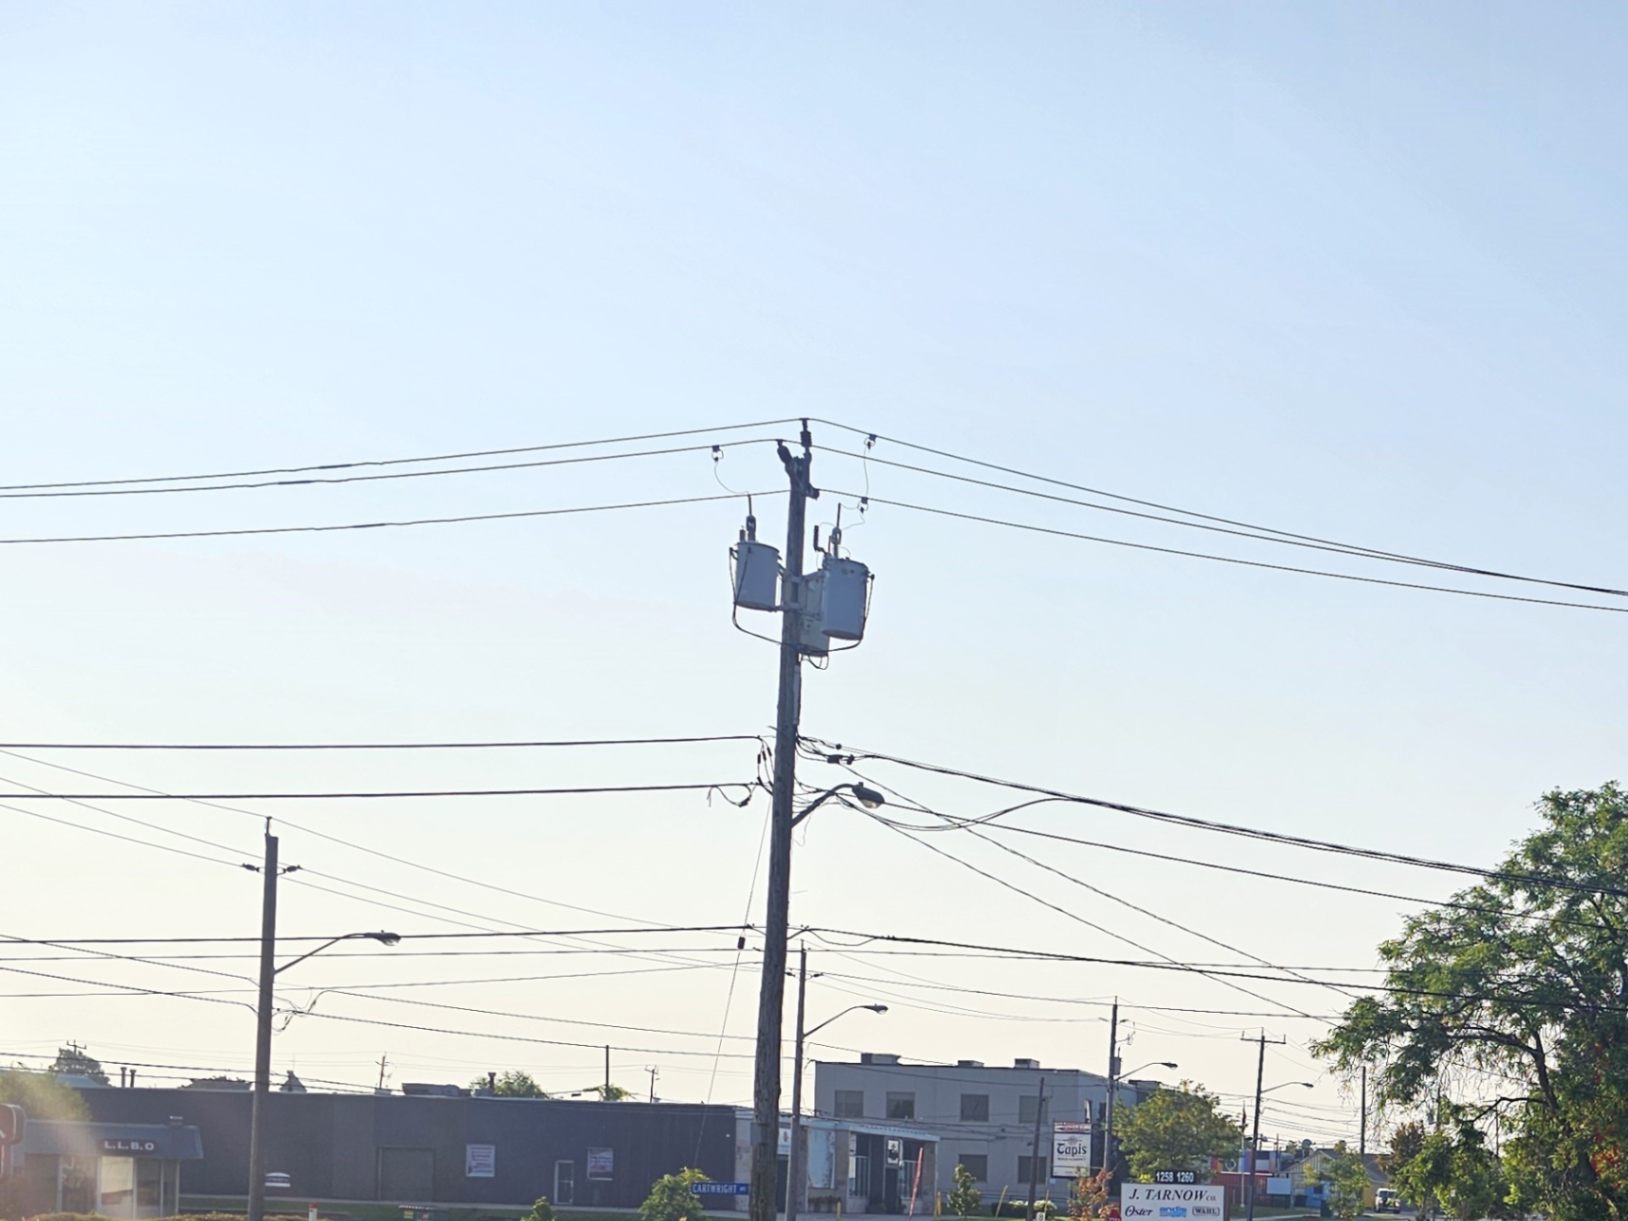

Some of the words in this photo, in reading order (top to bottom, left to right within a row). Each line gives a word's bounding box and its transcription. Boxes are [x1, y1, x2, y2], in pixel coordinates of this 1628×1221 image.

[1056, 1142, 1087, 1157] Tapis
[1156, 1171, 1174, 1182] 1258
[1176, 1171, 1194, 1182] 1260
[692, 1183, 737, 1194] CARTWRIGHT
[1128, 1188, 1140, 1200] J.
[1145, 1188, 1208, 1201] TARNOW
[1124, 1205, 1153, 1217] Oster
[1194, 1207, 1217, 1216] WAHL
